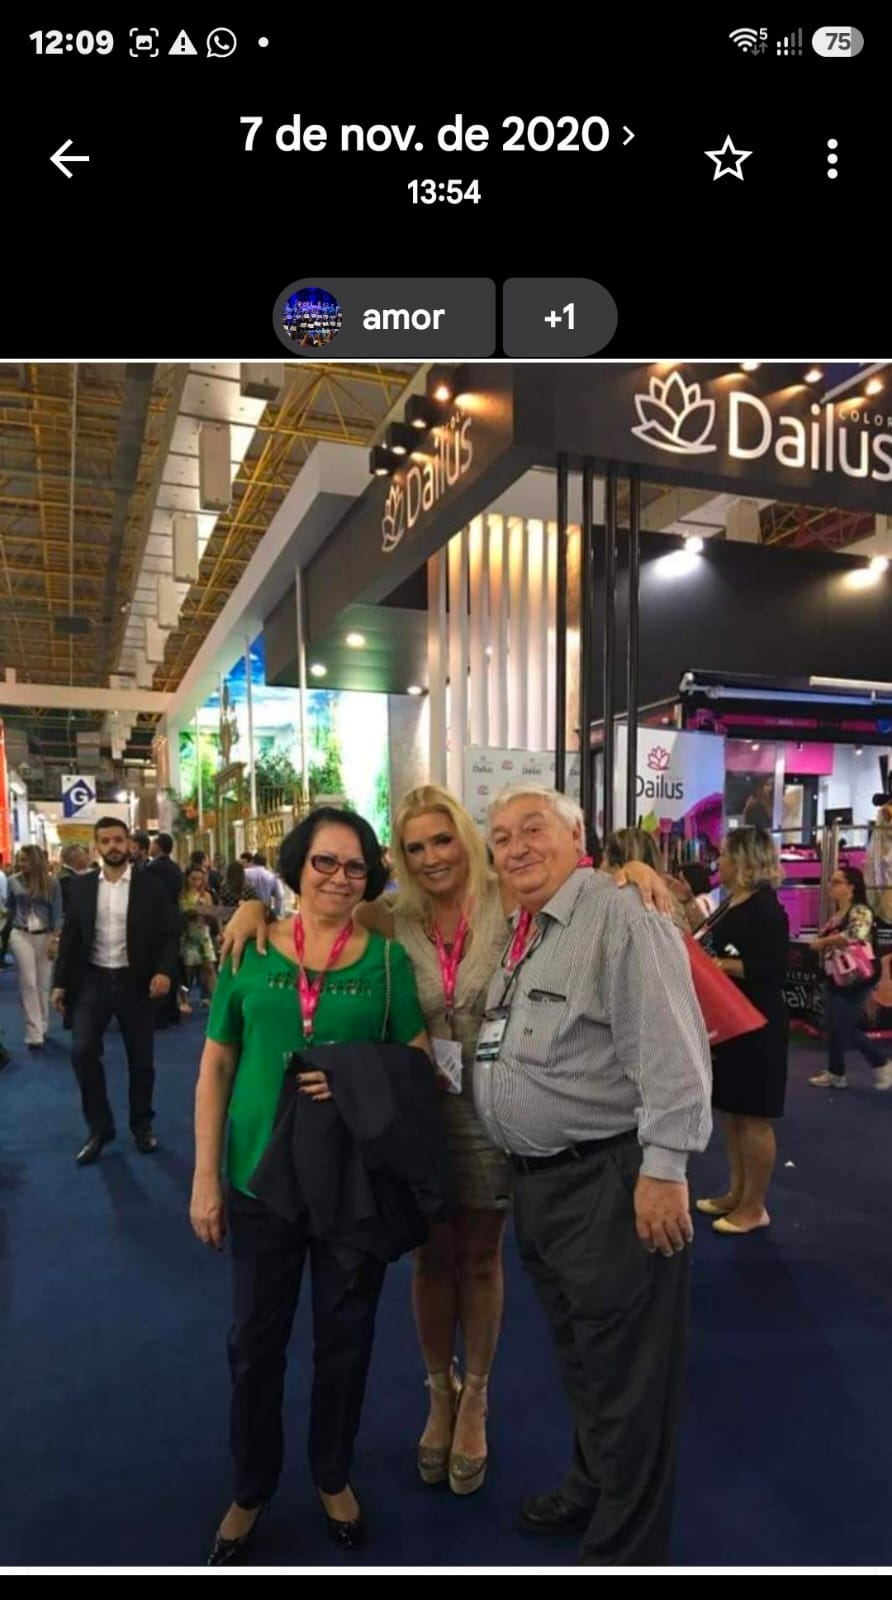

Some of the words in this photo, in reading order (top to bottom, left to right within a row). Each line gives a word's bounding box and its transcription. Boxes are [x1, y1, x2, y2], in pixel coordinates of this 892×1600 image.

[728, 390, 892, 482] Dailus
[406, 415, 474, 529] Dailus
[70, 787, 89, 806] G
[636, 774, 684, 800] Dailus
